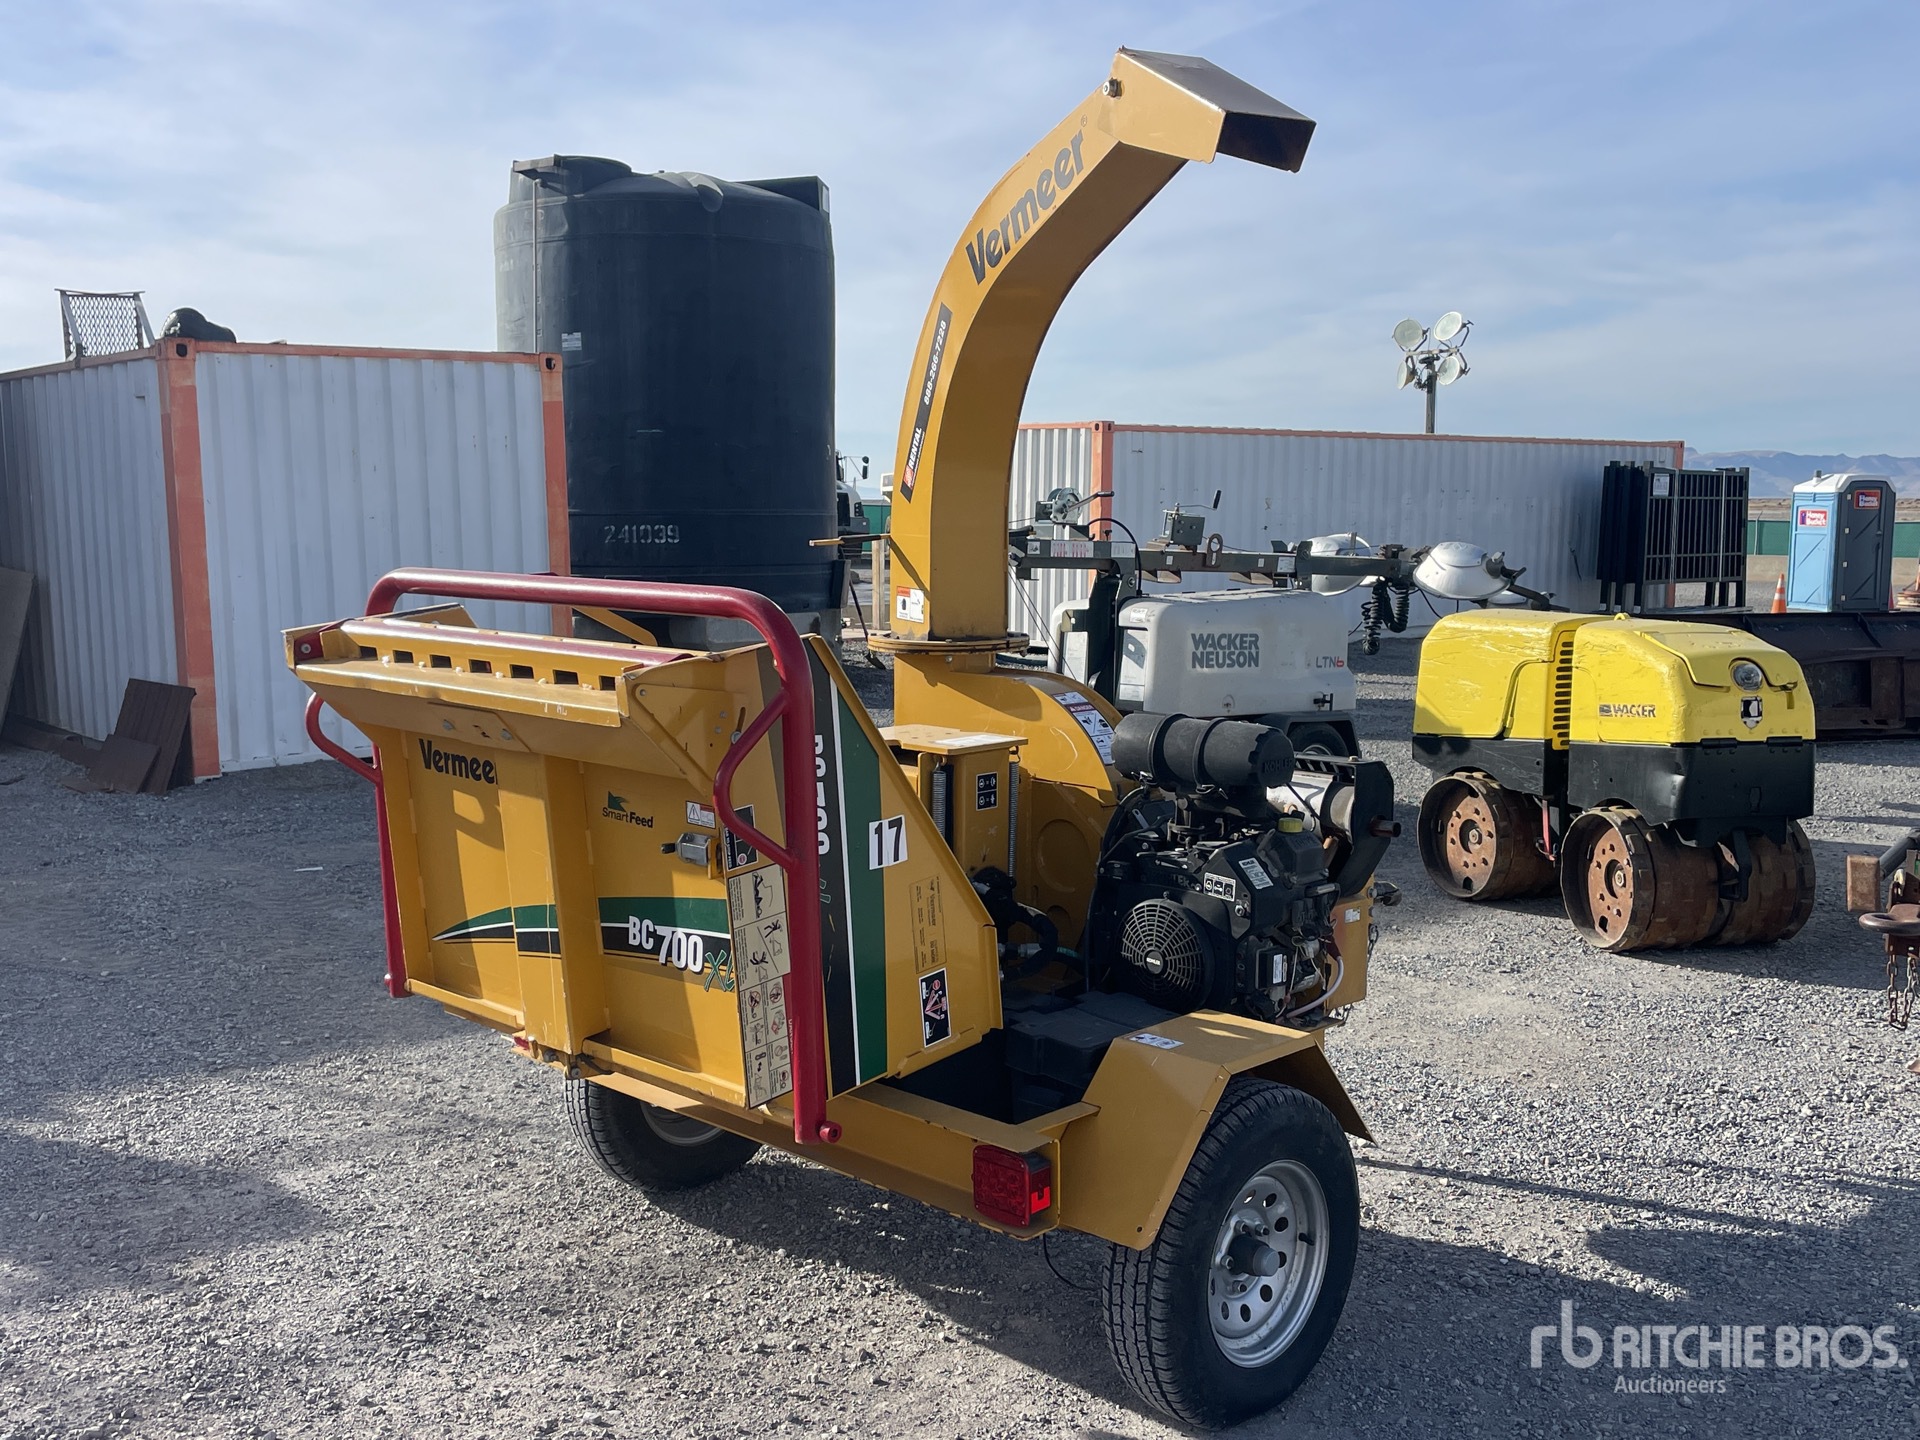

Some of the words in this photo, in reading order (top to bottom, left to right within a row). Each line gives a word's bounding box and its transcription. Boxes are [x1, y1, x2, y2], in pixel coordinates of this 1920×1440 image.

[965, 129, 1084, 286] Vermeer
[908, 428, 922, 470] RENTAL
[604, 525, 680, 543] 241039
[1191, 633, 1260, 650] WACKER
[1191, 651, 1260, 669] NEUSON
[1612, 704, 1656, 718] WACKER
[418, 738, 498, 785] Vermee
[874, 817, 903, 867] 17
